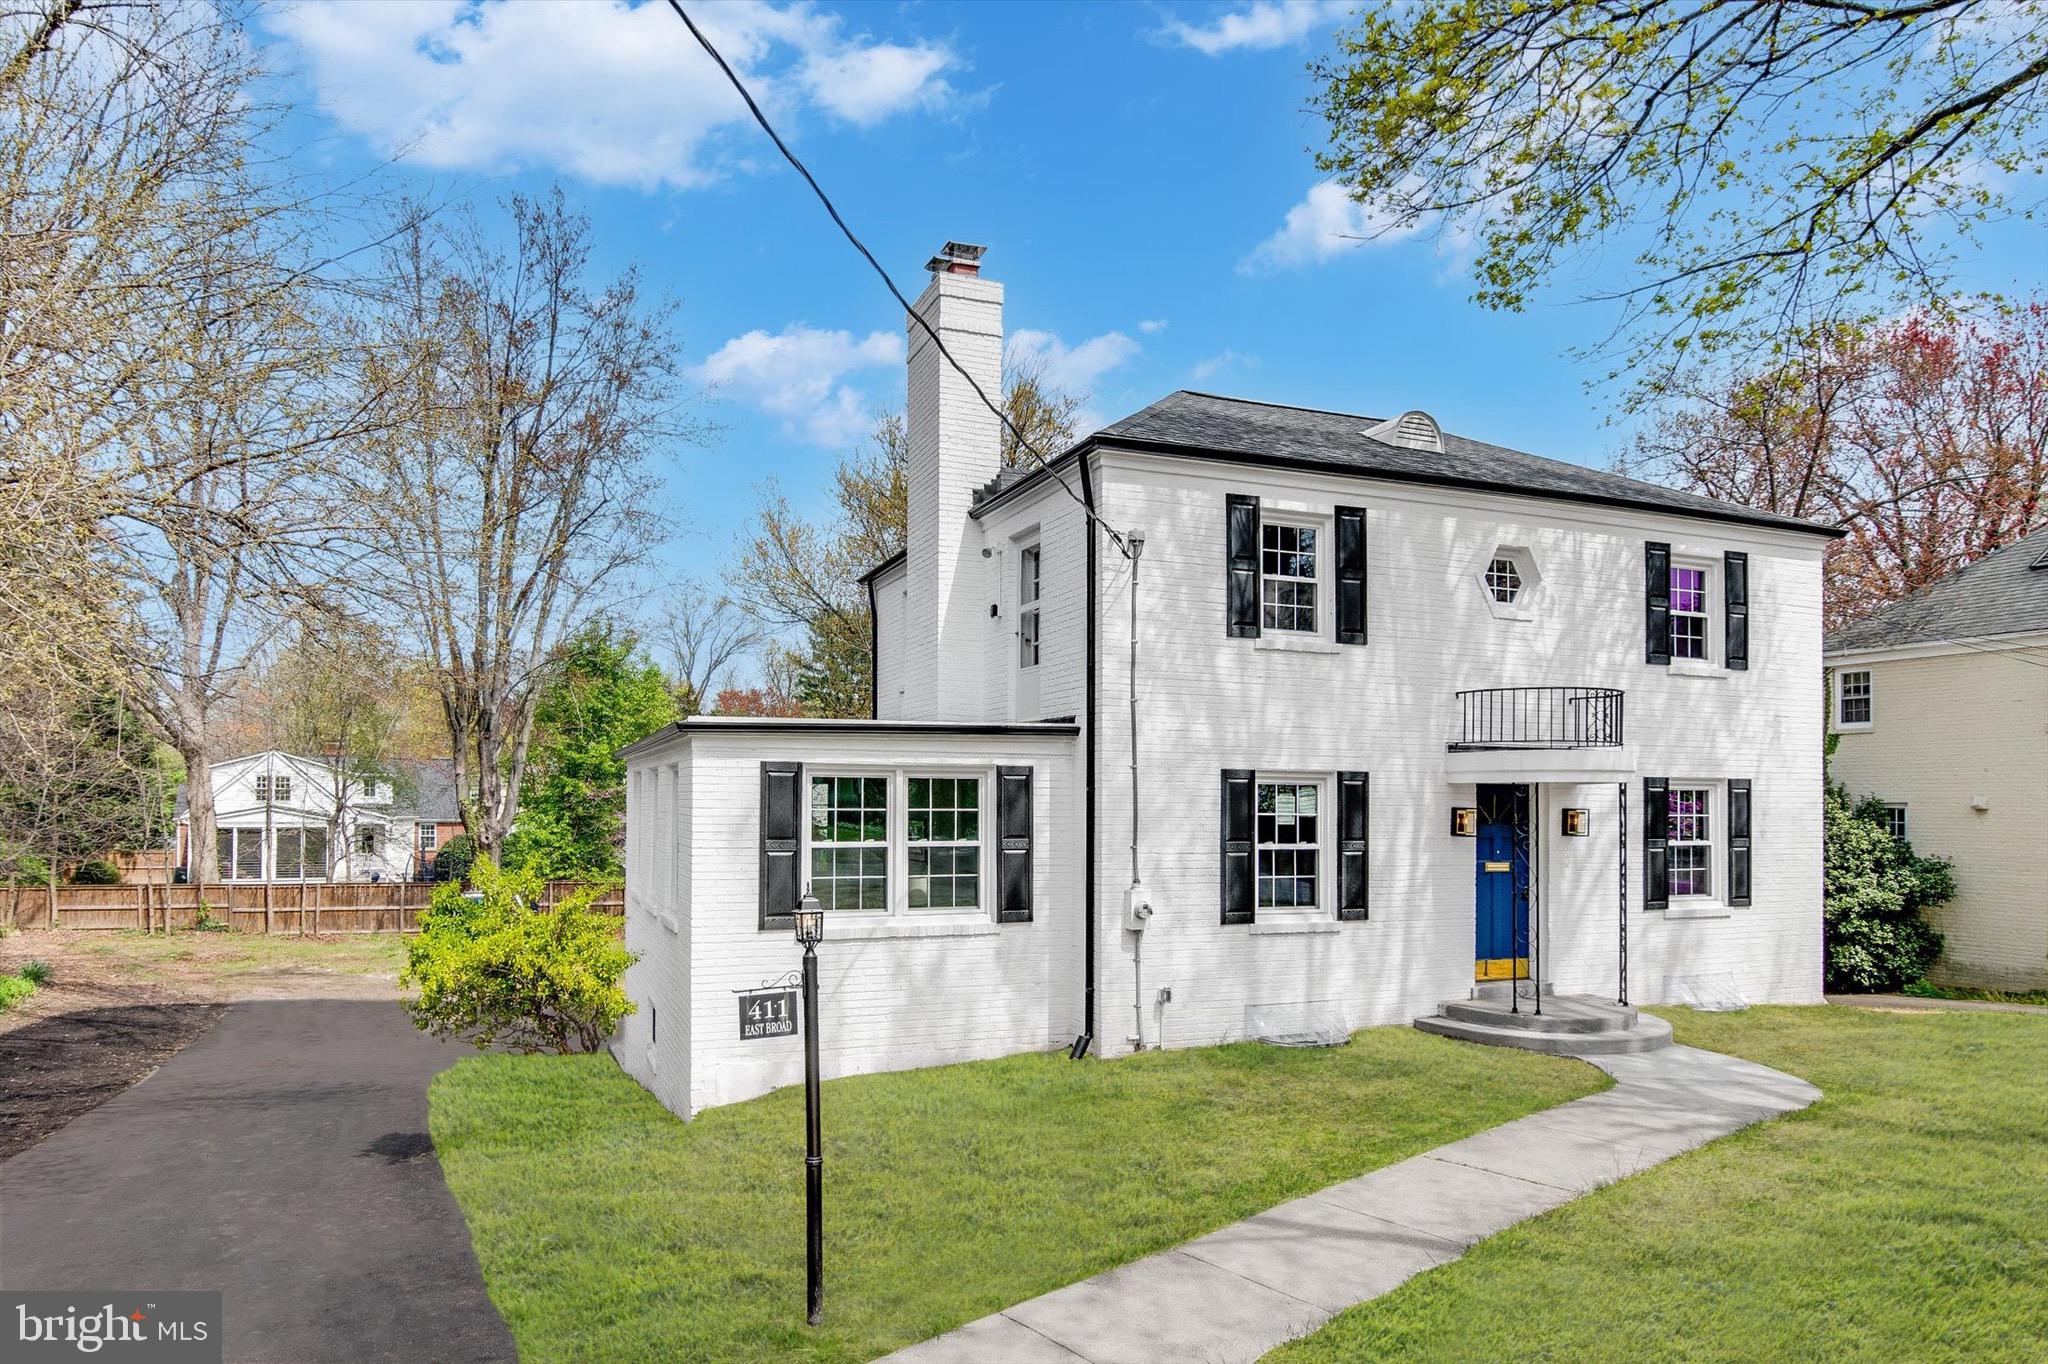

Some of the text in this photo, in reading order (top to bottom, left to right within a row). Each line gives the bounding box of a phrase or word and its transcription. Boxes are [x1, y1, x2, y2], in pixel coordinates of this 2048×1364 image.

[748, 999, 788, 1020] 411
[745, 1020, 792, 1036] EAST BROAD
